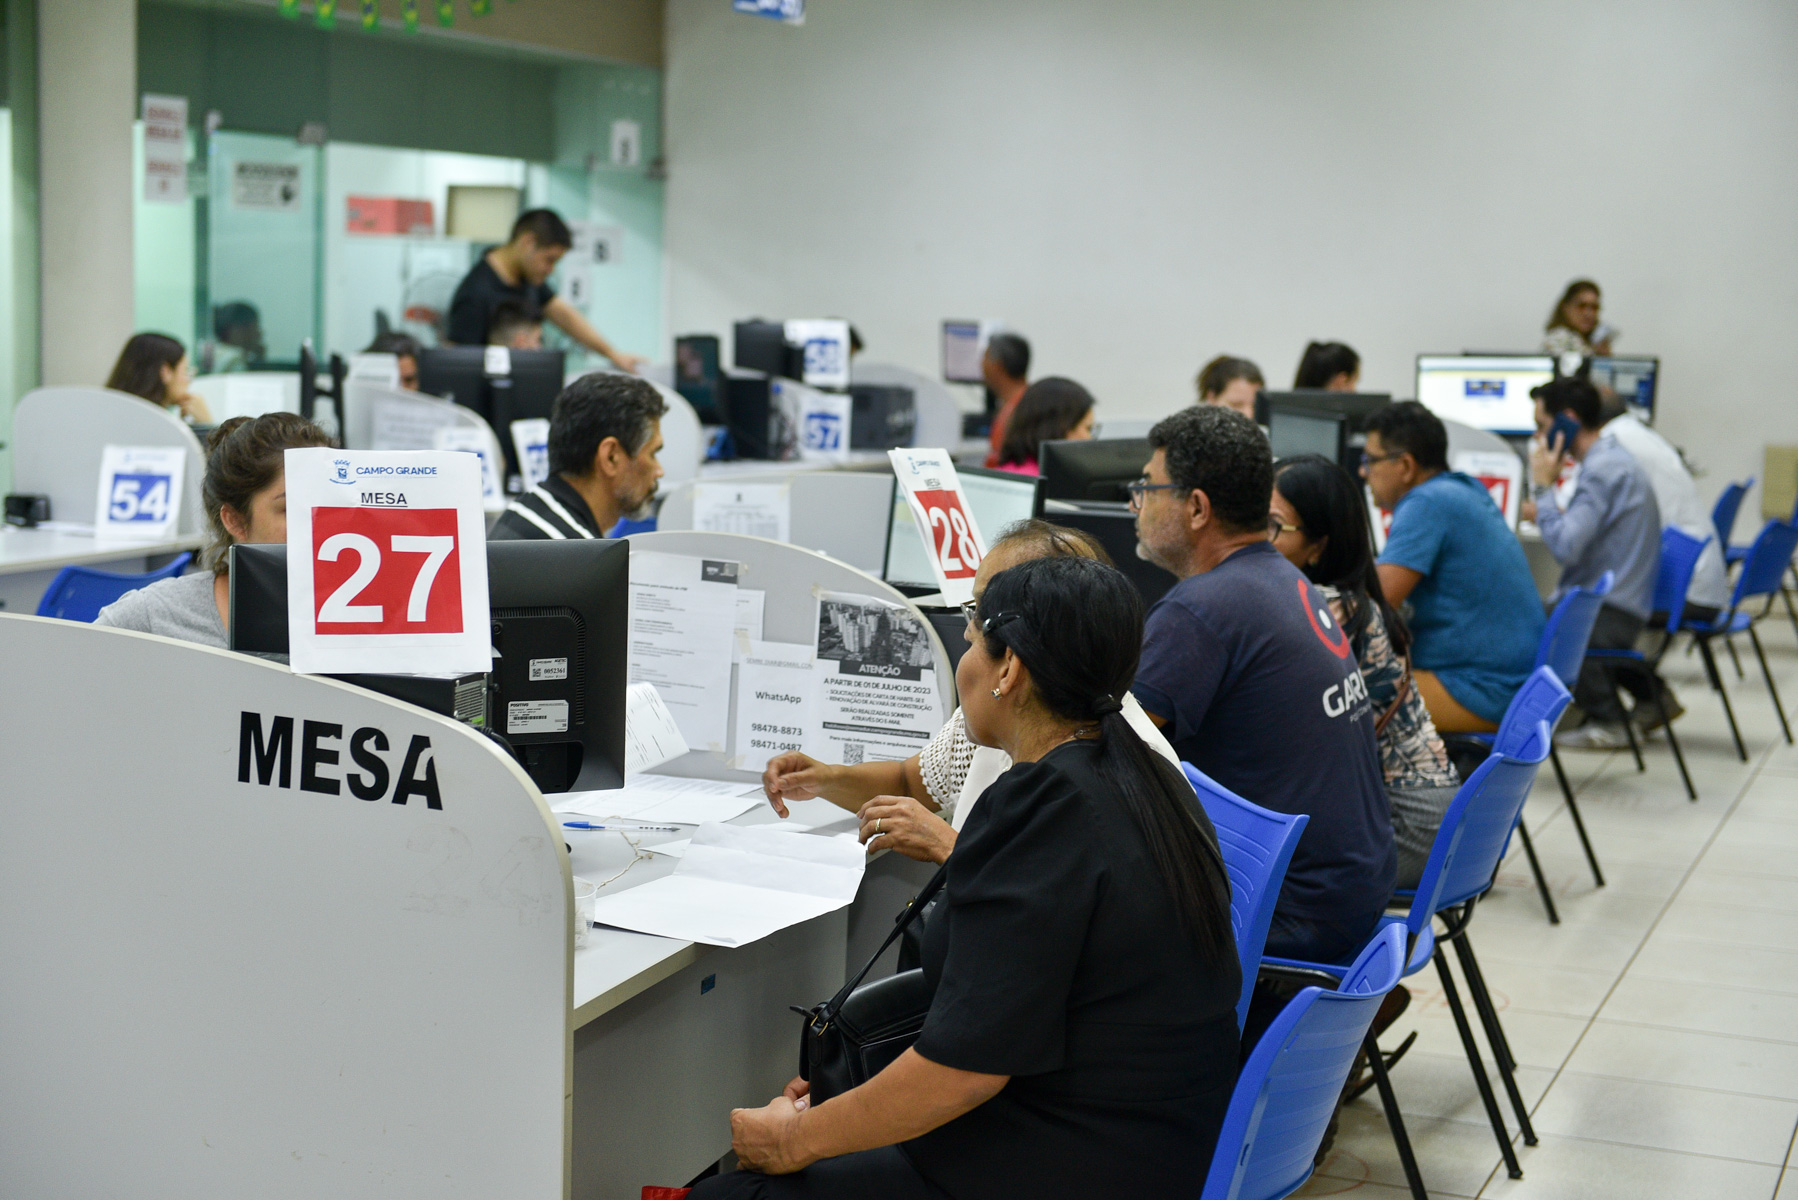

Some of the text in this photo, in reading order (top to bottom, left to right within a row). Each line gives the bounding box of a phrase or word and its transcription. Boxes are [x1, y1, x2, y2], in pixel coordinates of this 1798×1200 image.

[805, 420, 839, 450] 57
[356, 466, 437, 475] CAMPO GRANDE
[111, 479, 169, 521] 54
[361, 492, 408, 505] MESA
[928, 506, 981, 572] 28
[317, 532, 455, 623] 27
[858, 664, 902, 677] ATENÇÃO
[830, 679, 853, 687] PARTIR
[853, 680, 862, 688] DE
[863, 681, 871, 689] 01
[881, 683, 903, 692] JULHO
[913, 686, 931, 695] 2023
[755, 691, 802, 704] WhatsApp
[829, 696, 862, 704] RENOVAÇÃO
[896, 702, 933, 711] CONSTRUÇÃO
[851, 715, 875, 723] ATRAVÉS
[858, 708, 890, 717] REALIZADAS
[890, 711, 915, 719] SOMENTE
[751, 723, 803, 736] 98478-8873
[750, 740, 803, 752] 98471-0487
[237, 711, 443, 811] MESA
